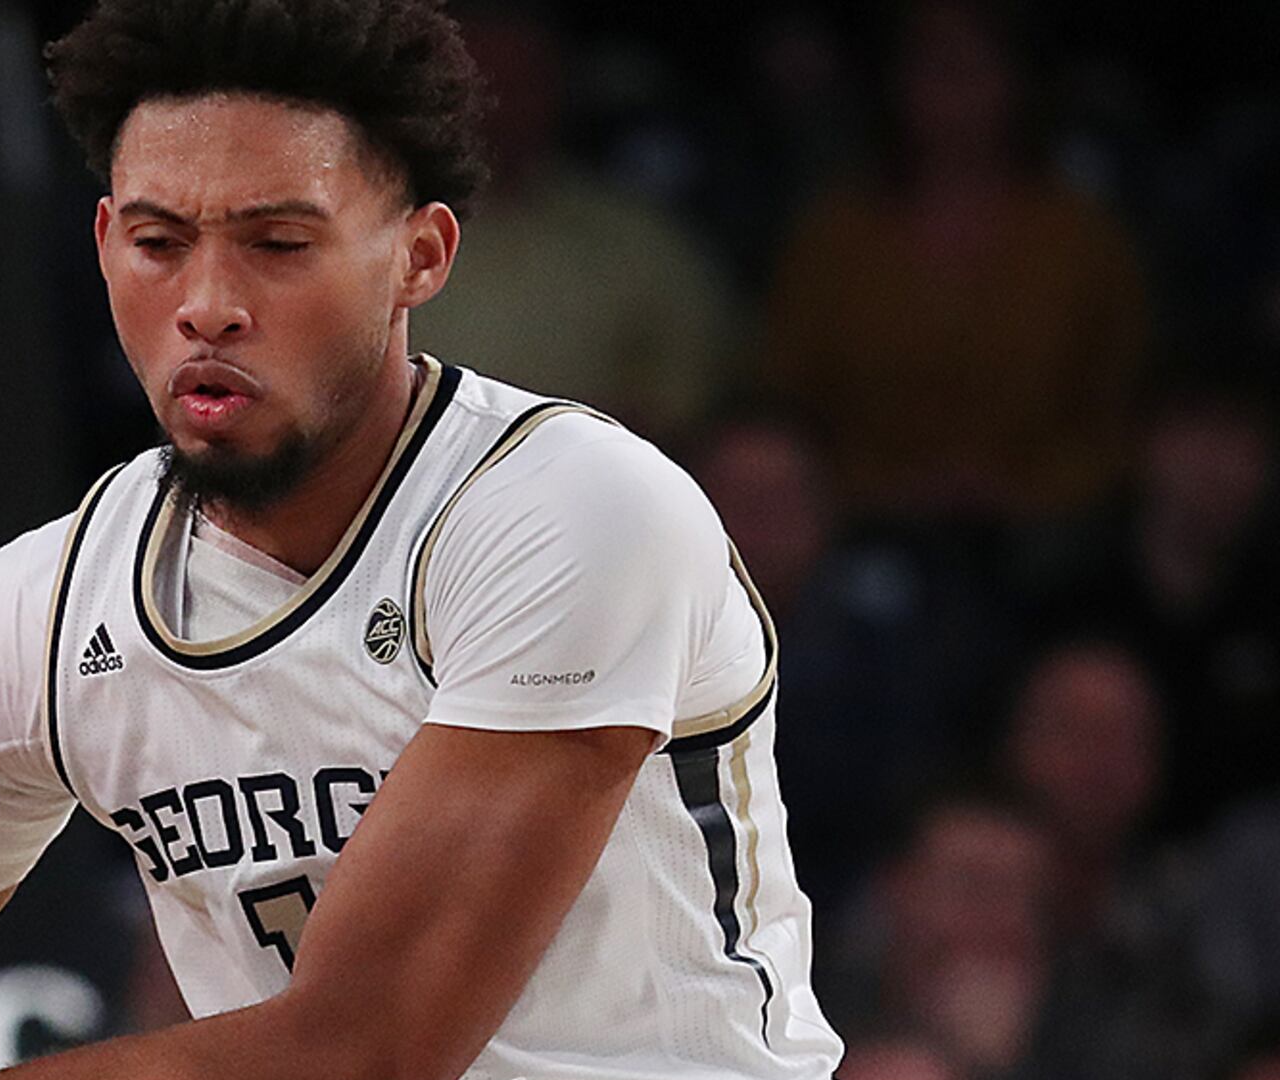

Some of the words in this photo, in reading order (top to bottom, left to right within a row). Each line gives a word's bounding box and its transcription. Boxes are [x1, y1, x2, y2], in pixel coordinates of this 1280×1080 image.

[369, 617, 401, 638] ACC
[79, 653, 124, 676] adidas
[510, 673, 584, 687] ALIGNMED
[109, 766, 391, 883] GEORG
